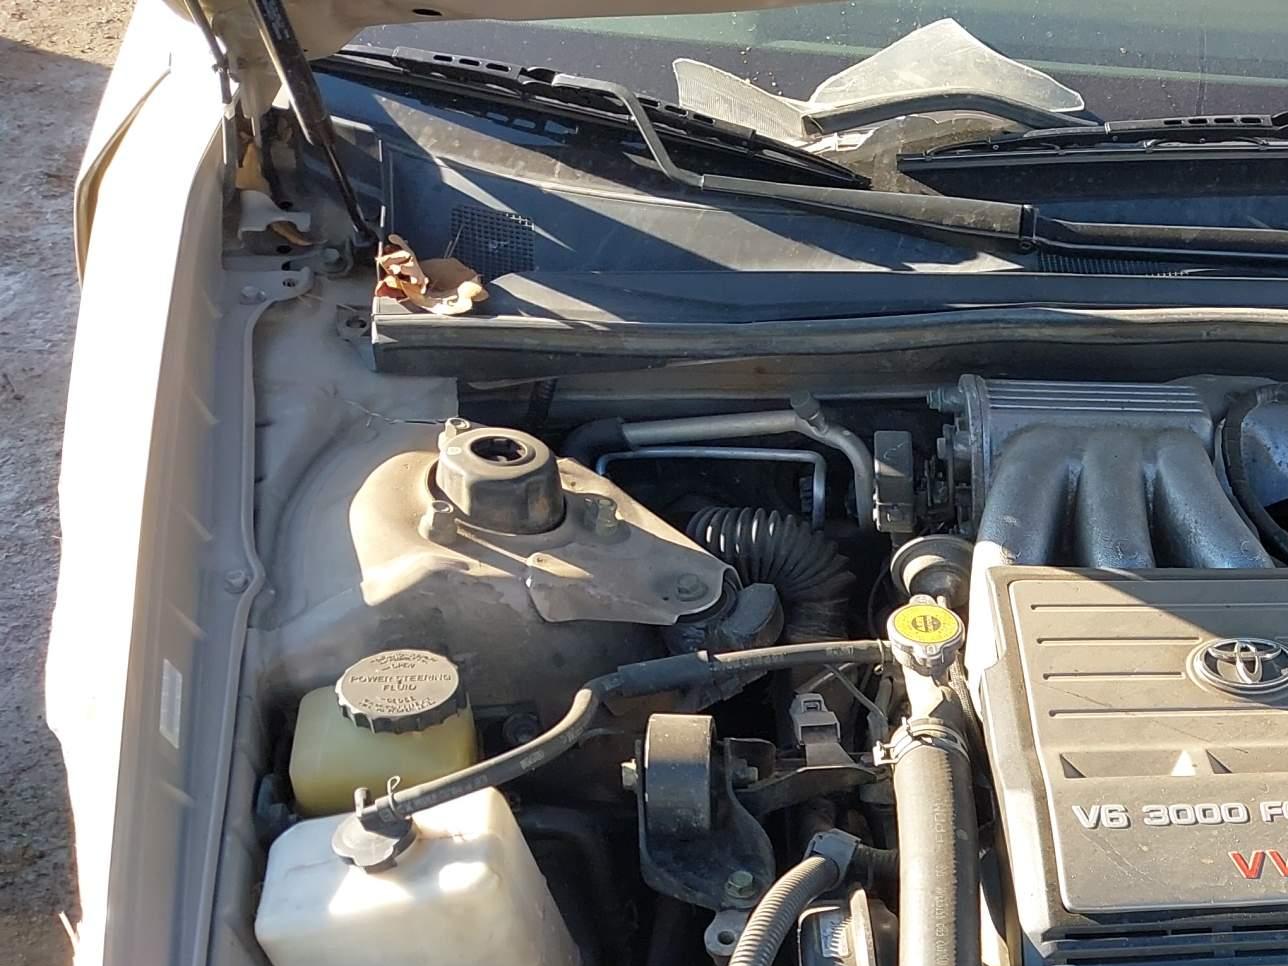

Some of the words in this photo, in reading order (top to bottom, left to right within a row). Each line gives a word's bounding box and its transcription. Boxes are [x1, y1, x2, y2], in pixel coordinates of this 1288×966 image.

[383, 684, 417, 692] FLUID
[1072, 803, 1131, 829] V6
[1142, 802, 1250, 827] 3000
